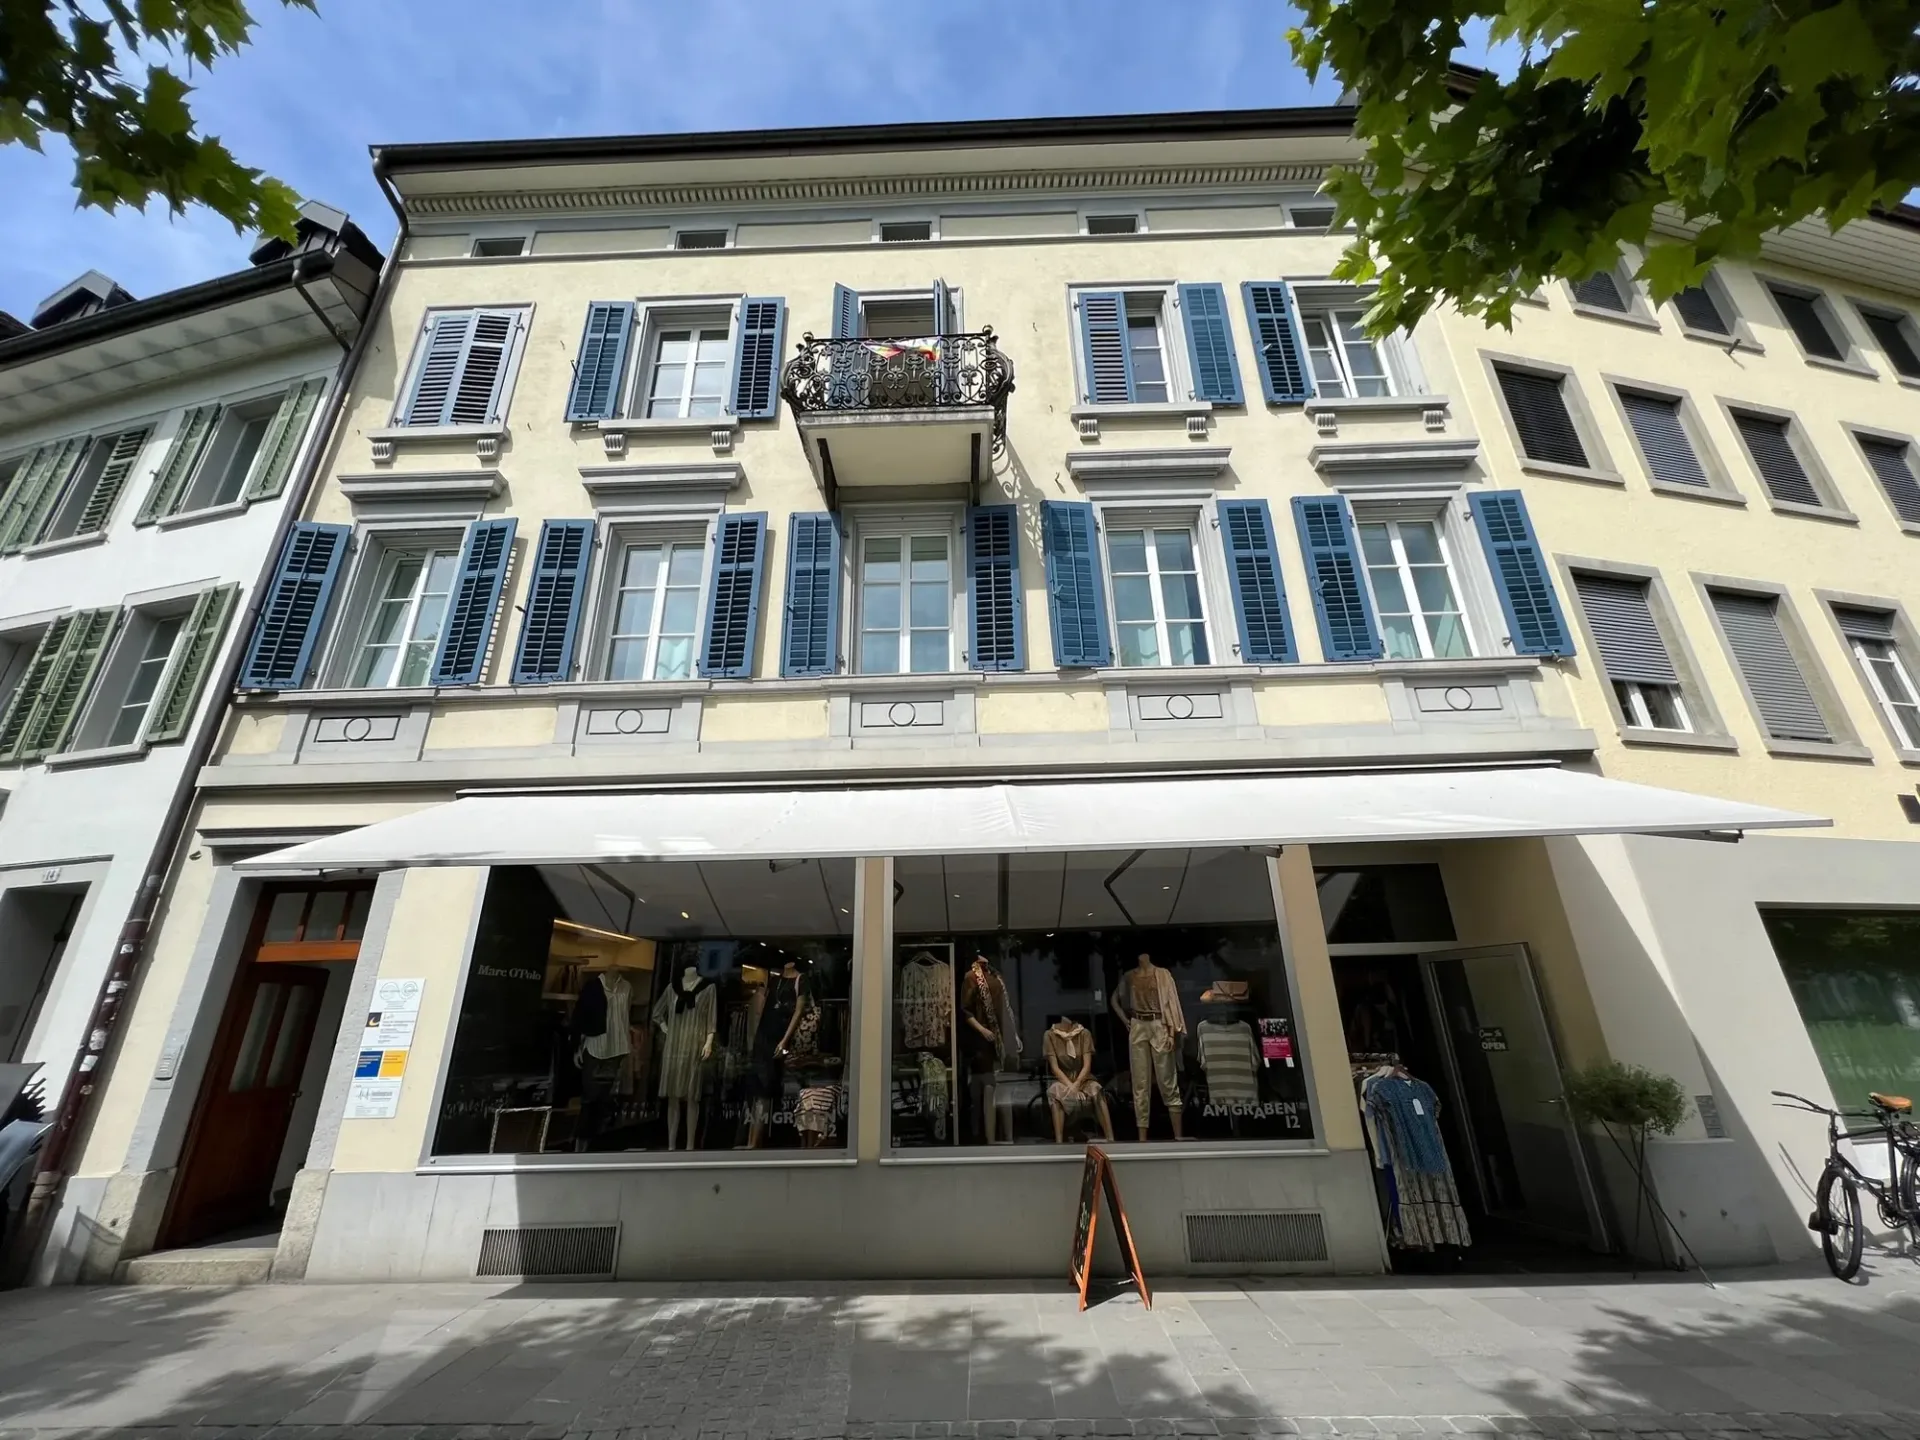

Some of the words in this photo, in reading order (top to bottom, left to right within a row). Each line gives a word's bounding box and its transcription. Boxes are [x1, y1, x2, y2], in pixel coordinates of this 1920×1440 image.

[478, 964, 508, 978] Marc
[1481, 1041, 1507, 1050] OPEN
[1202, 1104, 1229, 1118] AM
[1231, 1102, 1297, 1120] GRABEN
[1285, 1115, 1302, 1129] 12
